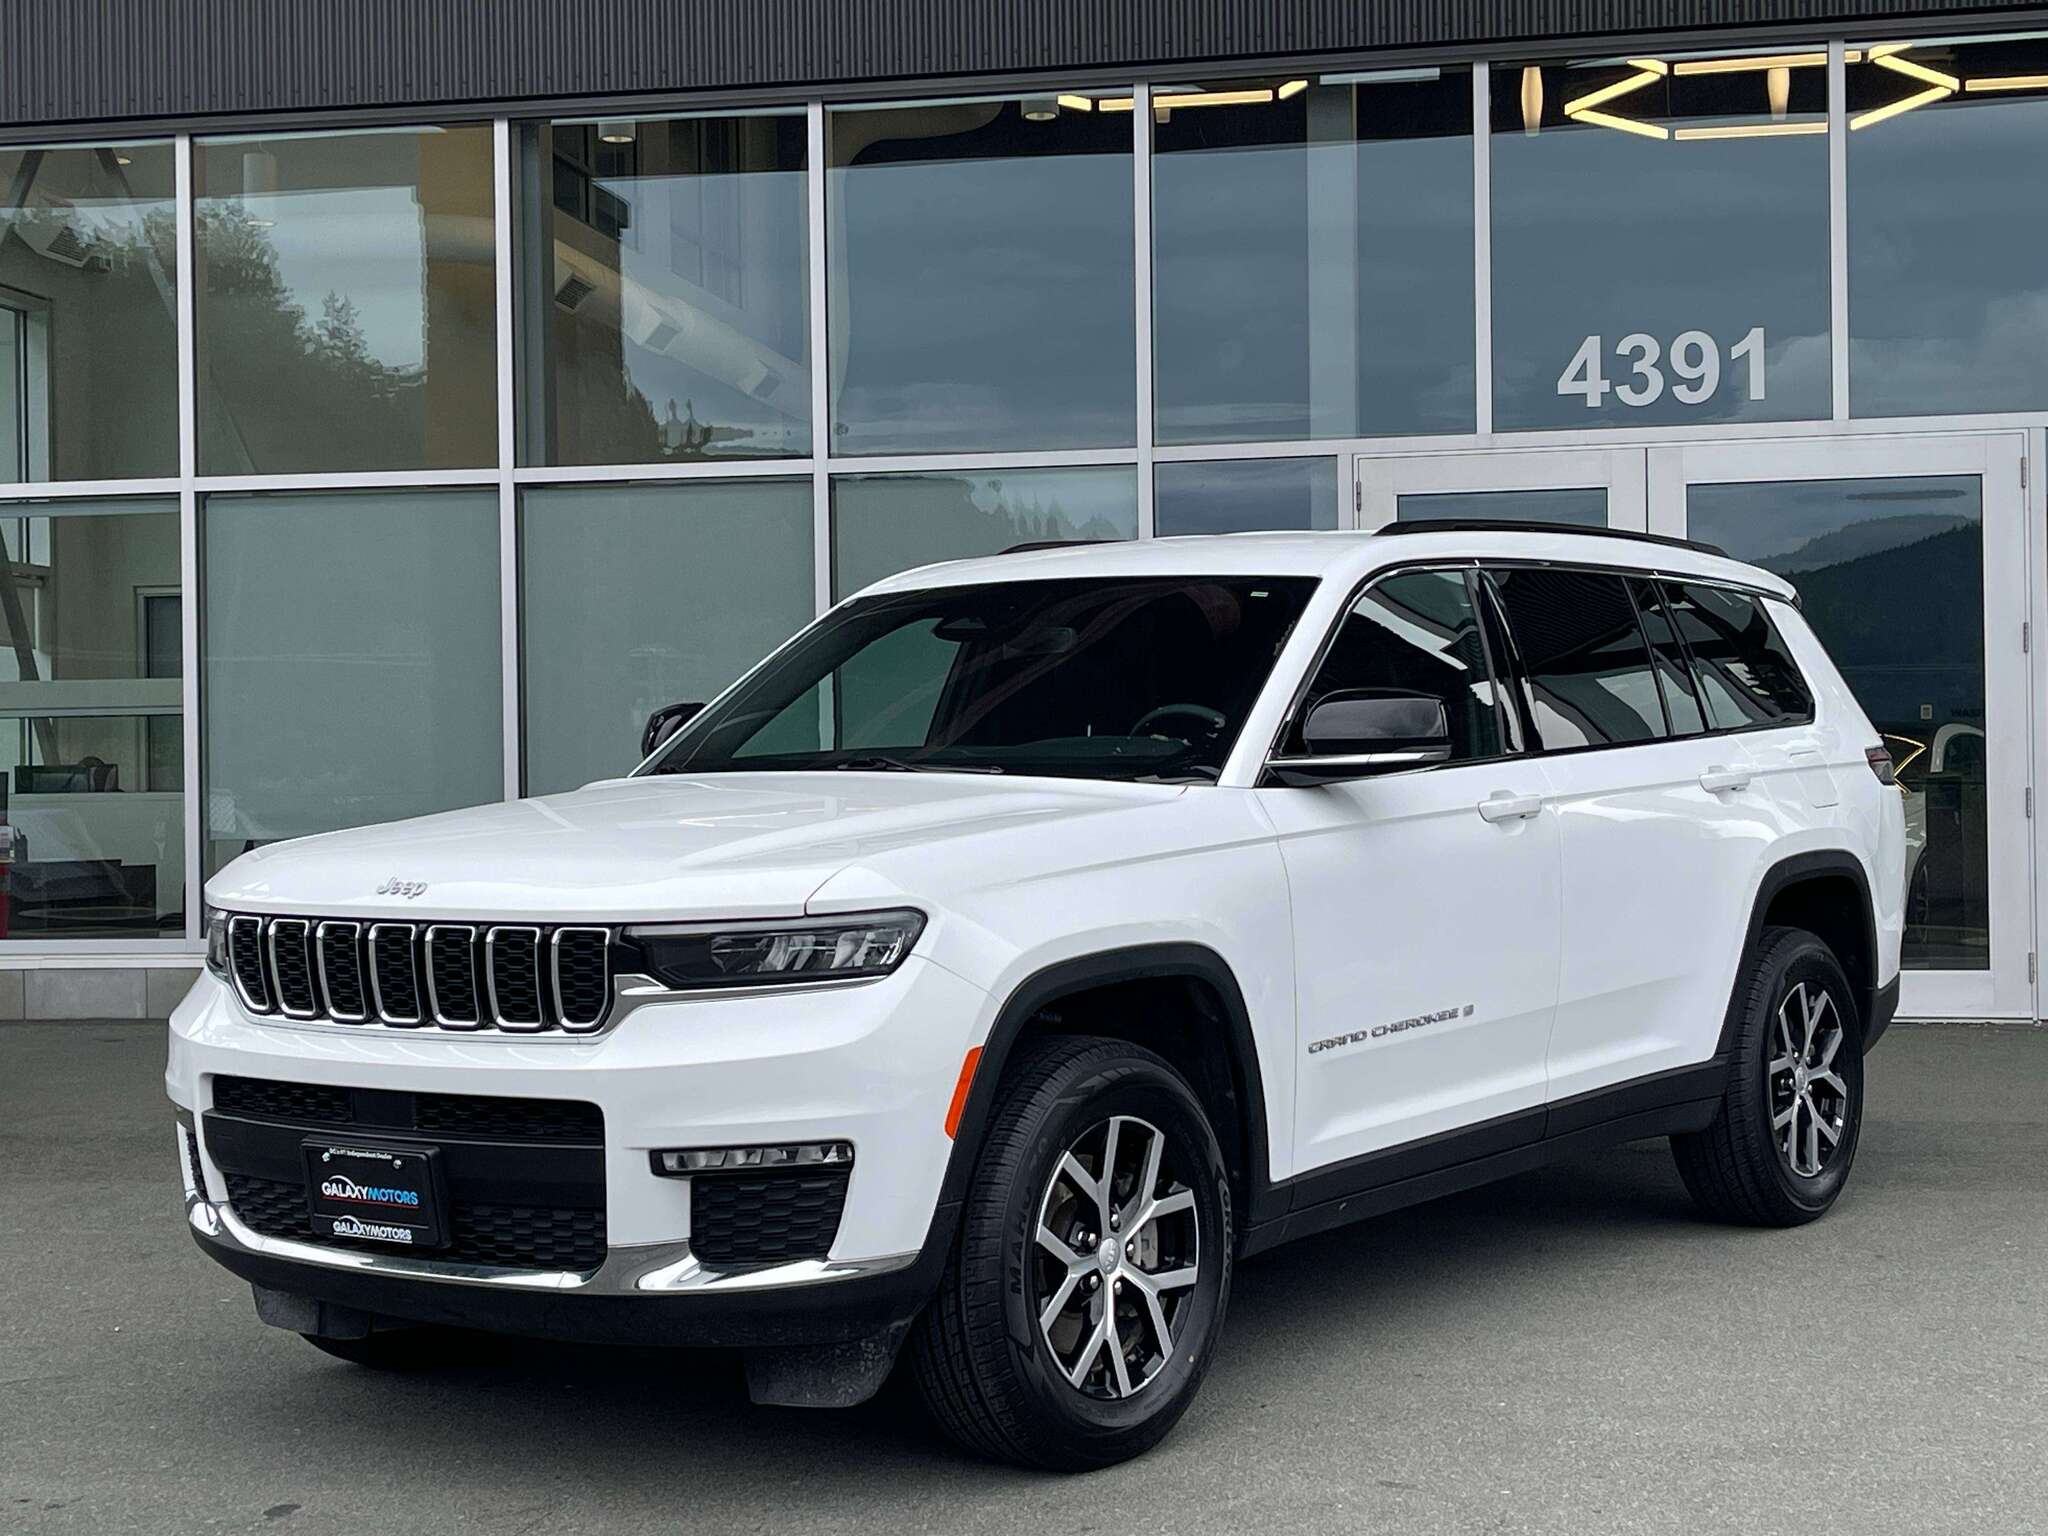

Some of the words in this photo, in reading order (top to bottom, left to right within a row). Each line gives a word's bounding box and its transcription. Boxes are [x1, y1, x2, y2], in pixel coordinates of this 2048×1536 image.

[1557, 327, 1765, 408] 4391
[376, 876, 428, 900] Jeep
[1308, 1030, 1368, 1054] GRAND
[1371, 1007, 1460, 1038] CHEROKEE
[347, 1150, 377, 1159] Independent
